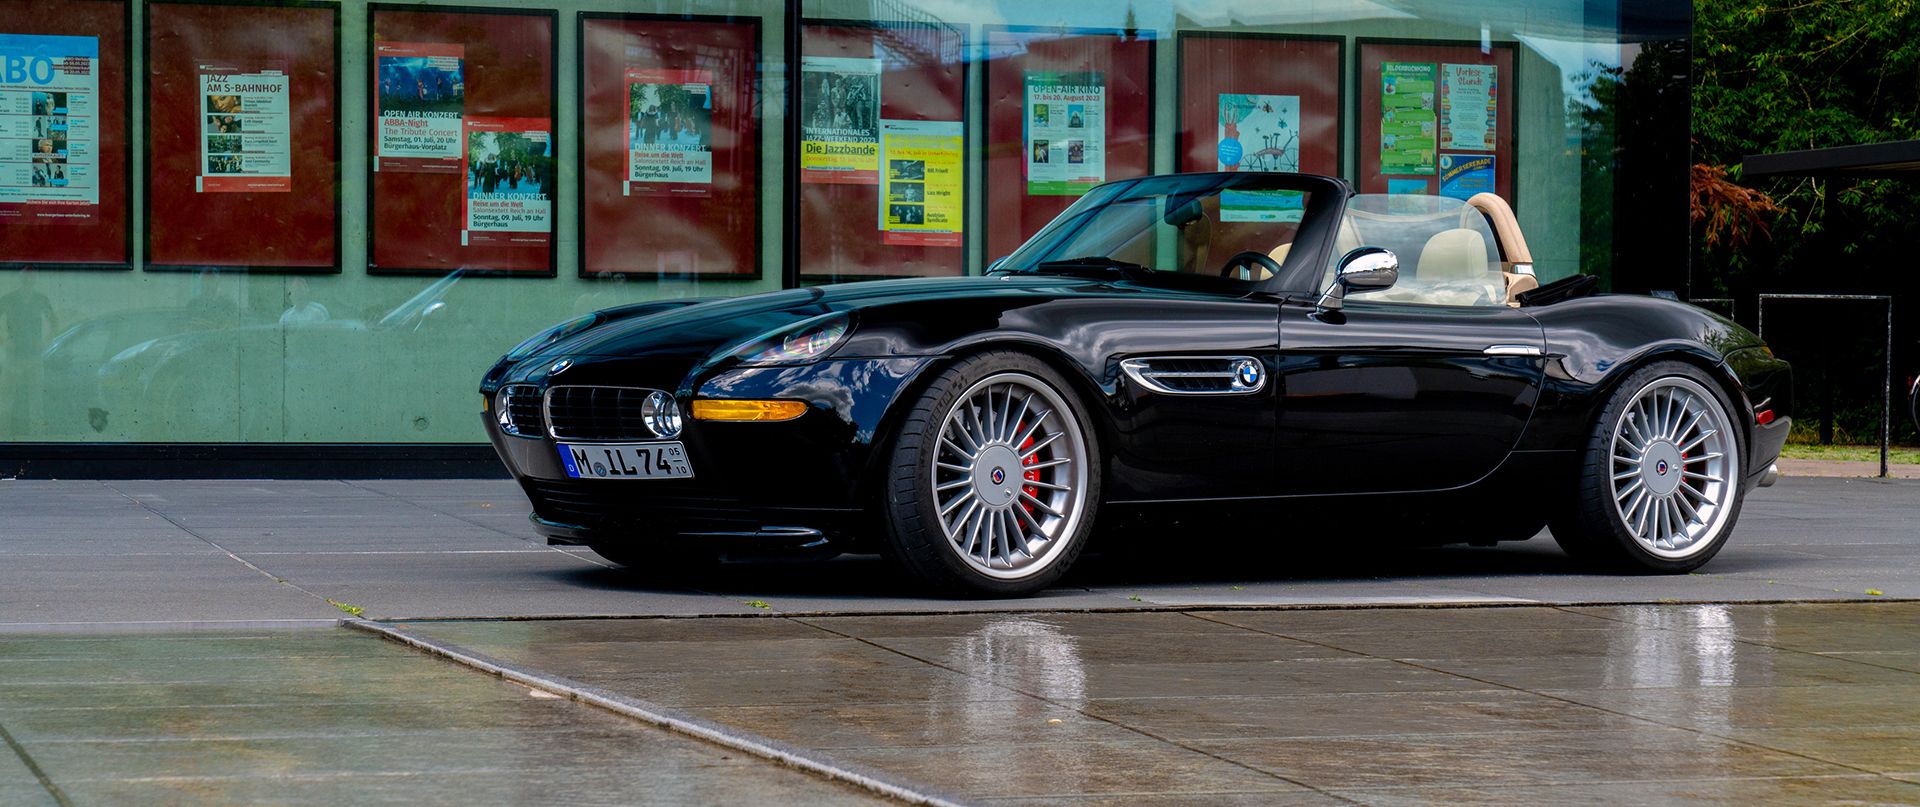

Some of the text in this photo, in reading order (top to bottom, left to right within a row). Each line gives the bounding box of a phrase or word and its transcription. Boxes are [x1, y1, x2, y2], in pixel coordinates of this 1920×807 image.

[0, 54, 55, 84] BO
[207, 74, 228, 83] JAZZ
[207, 84, 282, 93] AM S-BAHNHOF
[1033, 86, 1100, 94] OPEN-AIR KINO
[384, 119, 428, 128] ABBA-Night
[806, 128, 870, 136] INTERNATIONALES
[806, 143, 875, 155] Die Jazzbande
[572, 448, 593, 474] M
